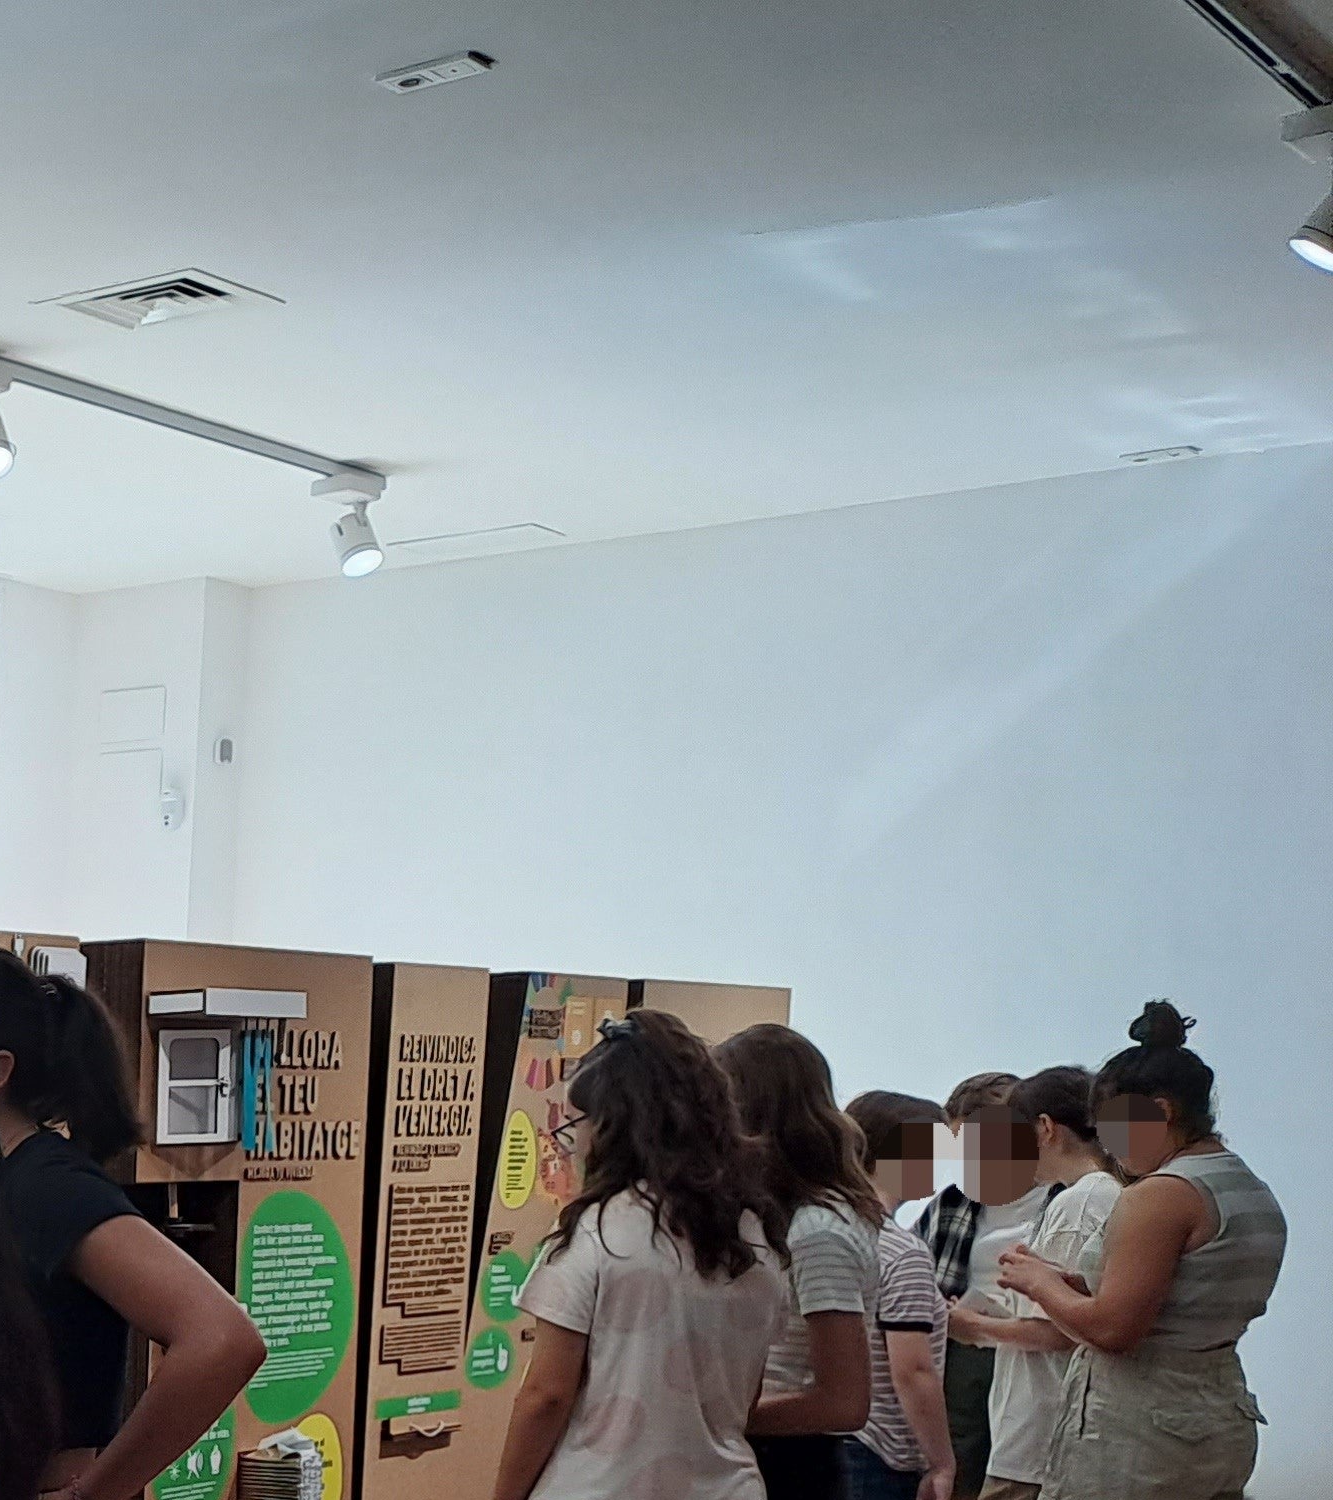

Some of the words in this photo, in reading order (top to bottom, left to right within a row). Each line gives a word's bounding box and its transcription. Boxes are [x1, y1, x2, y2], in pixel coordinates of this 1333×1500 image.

[399, 1034, 476, 1064] REIVINDICA
[278, 1075, 318, 1116] TEU
[396, 1067, 415, 1101] EL
[419, 1067, 459, 1101] DRET
